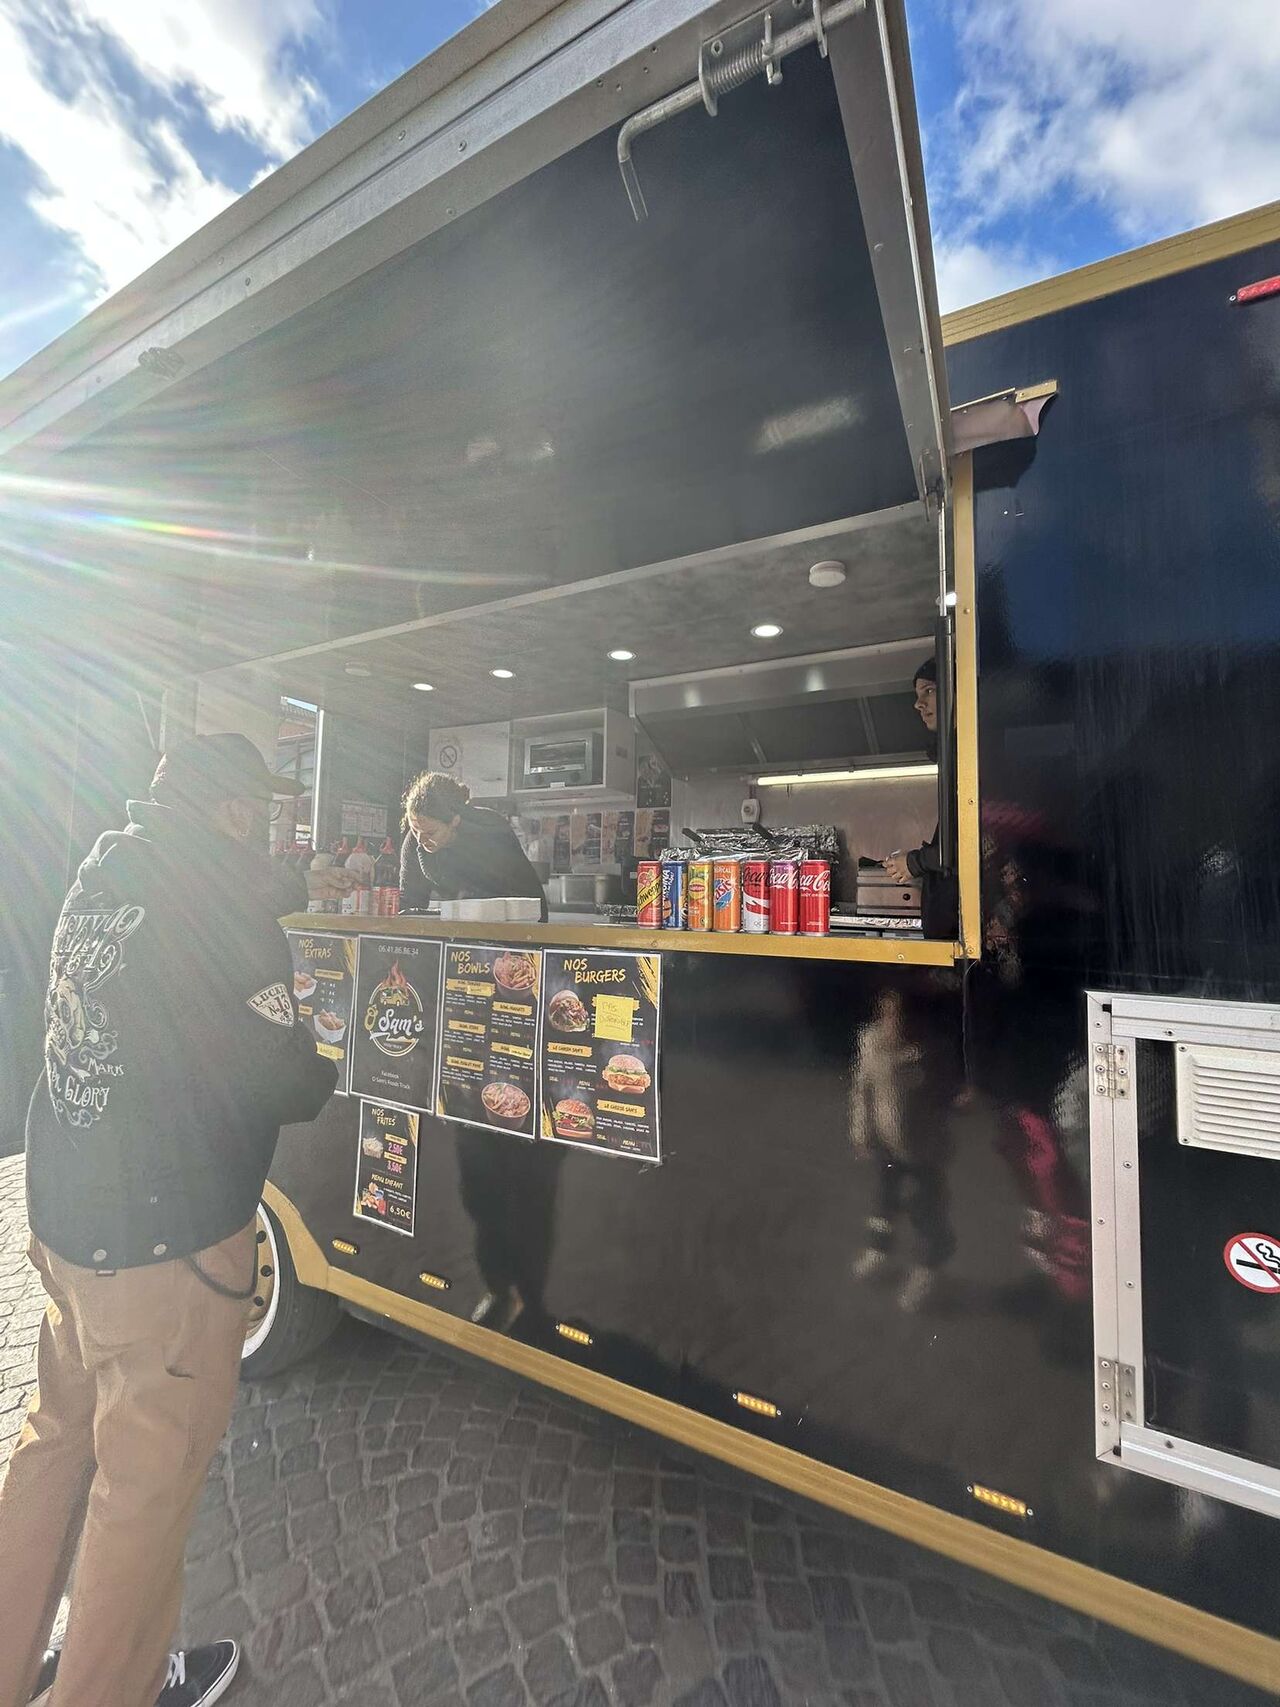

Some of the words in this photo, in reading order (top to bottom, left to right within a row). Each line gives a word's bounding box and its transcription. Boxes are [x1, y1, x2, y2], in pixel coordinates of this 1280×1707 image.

[298, 938, 314, 949] NOS
[304, 947, 332, 959] EXTRAS
[450, 950, 471, 962] NOS
[457, 962, 491, 974] BOWLS
[563, 957, 588, 971] NOS
[574, 968, 627, 984] BURGERS
[87, 1057, 124, 1077] MARK
[64, 1074, 110, 1113] GLORY
[371, 1108, 385, 1117] NOS
[376, 1116, 396, 1127] FRITES
